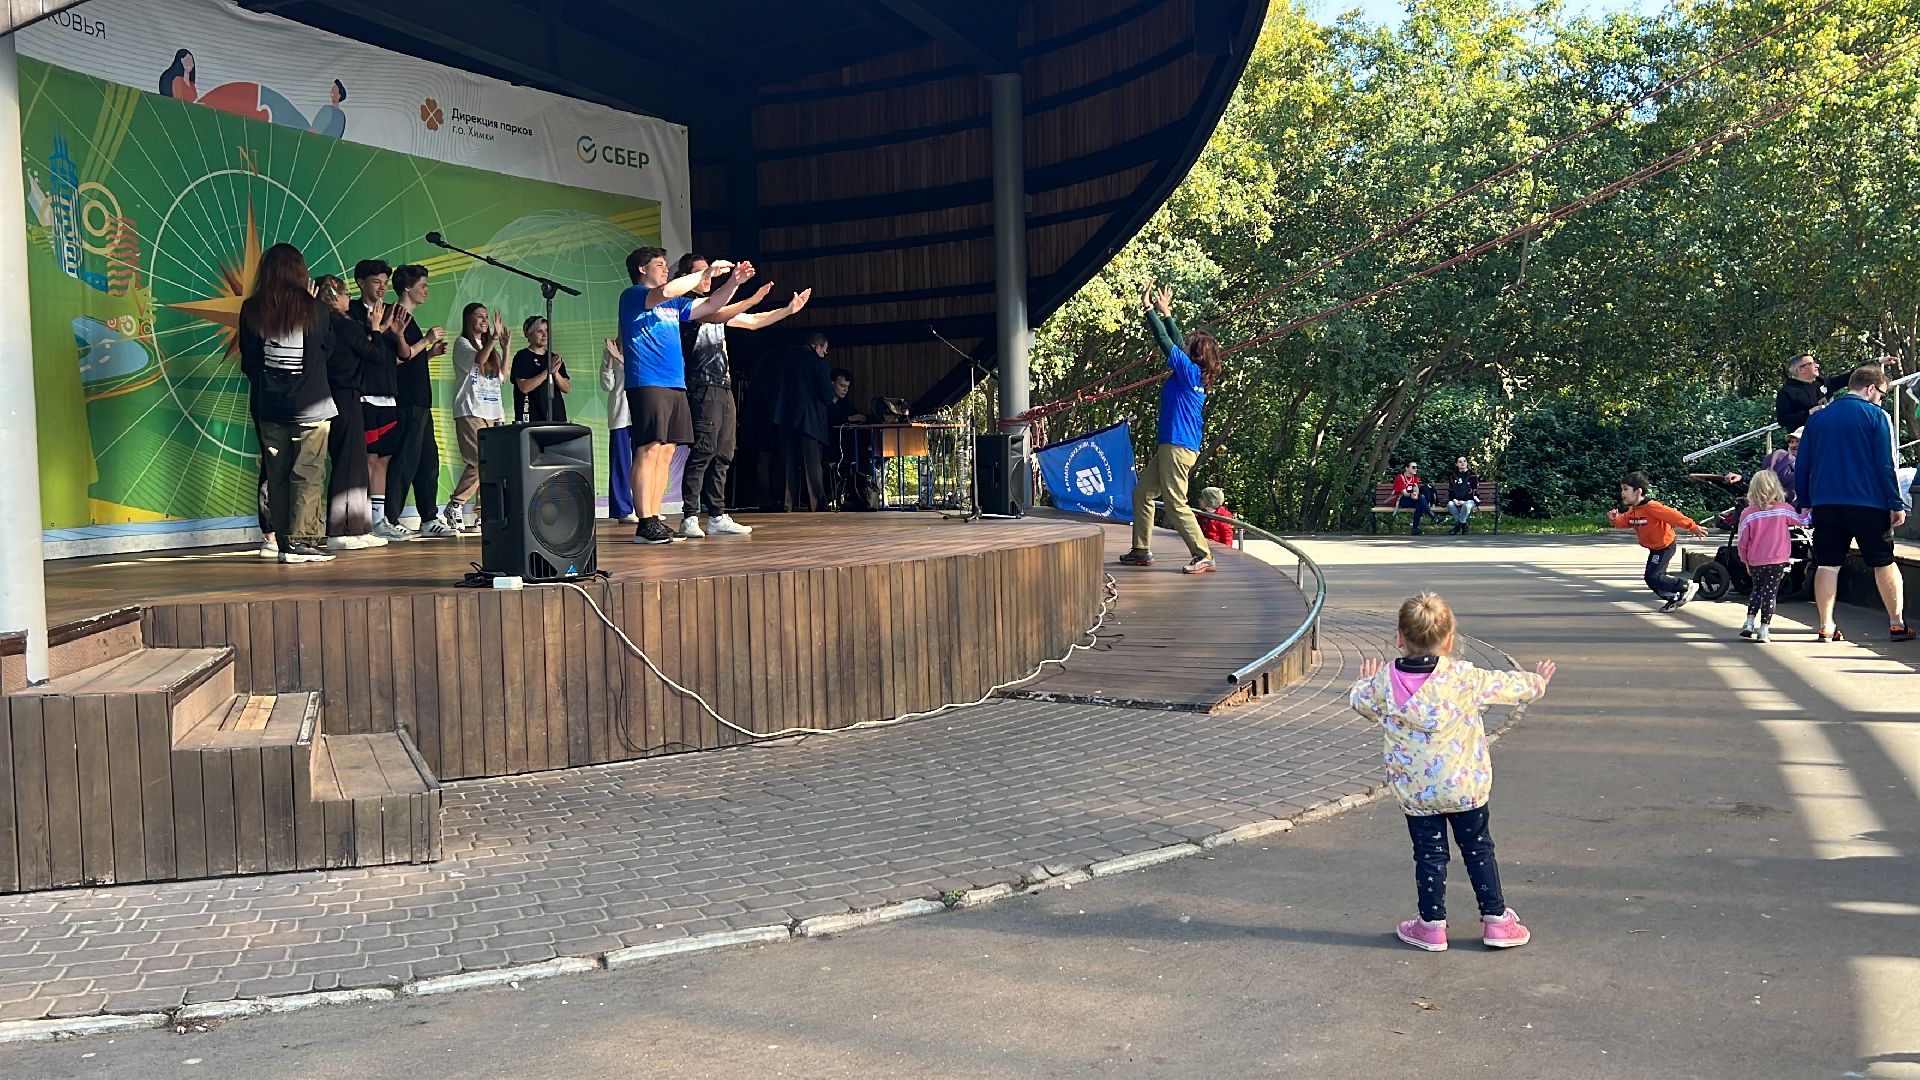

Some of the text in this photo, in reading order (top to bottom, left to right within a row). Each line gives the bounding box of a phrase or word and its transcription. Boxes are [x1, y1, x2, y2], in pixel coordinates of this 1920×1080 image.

[452, 108, 533, 136] Дирекция парков
[468, 126, 495, 141] Химки
[602, 145, 650, 169] СБЕР
